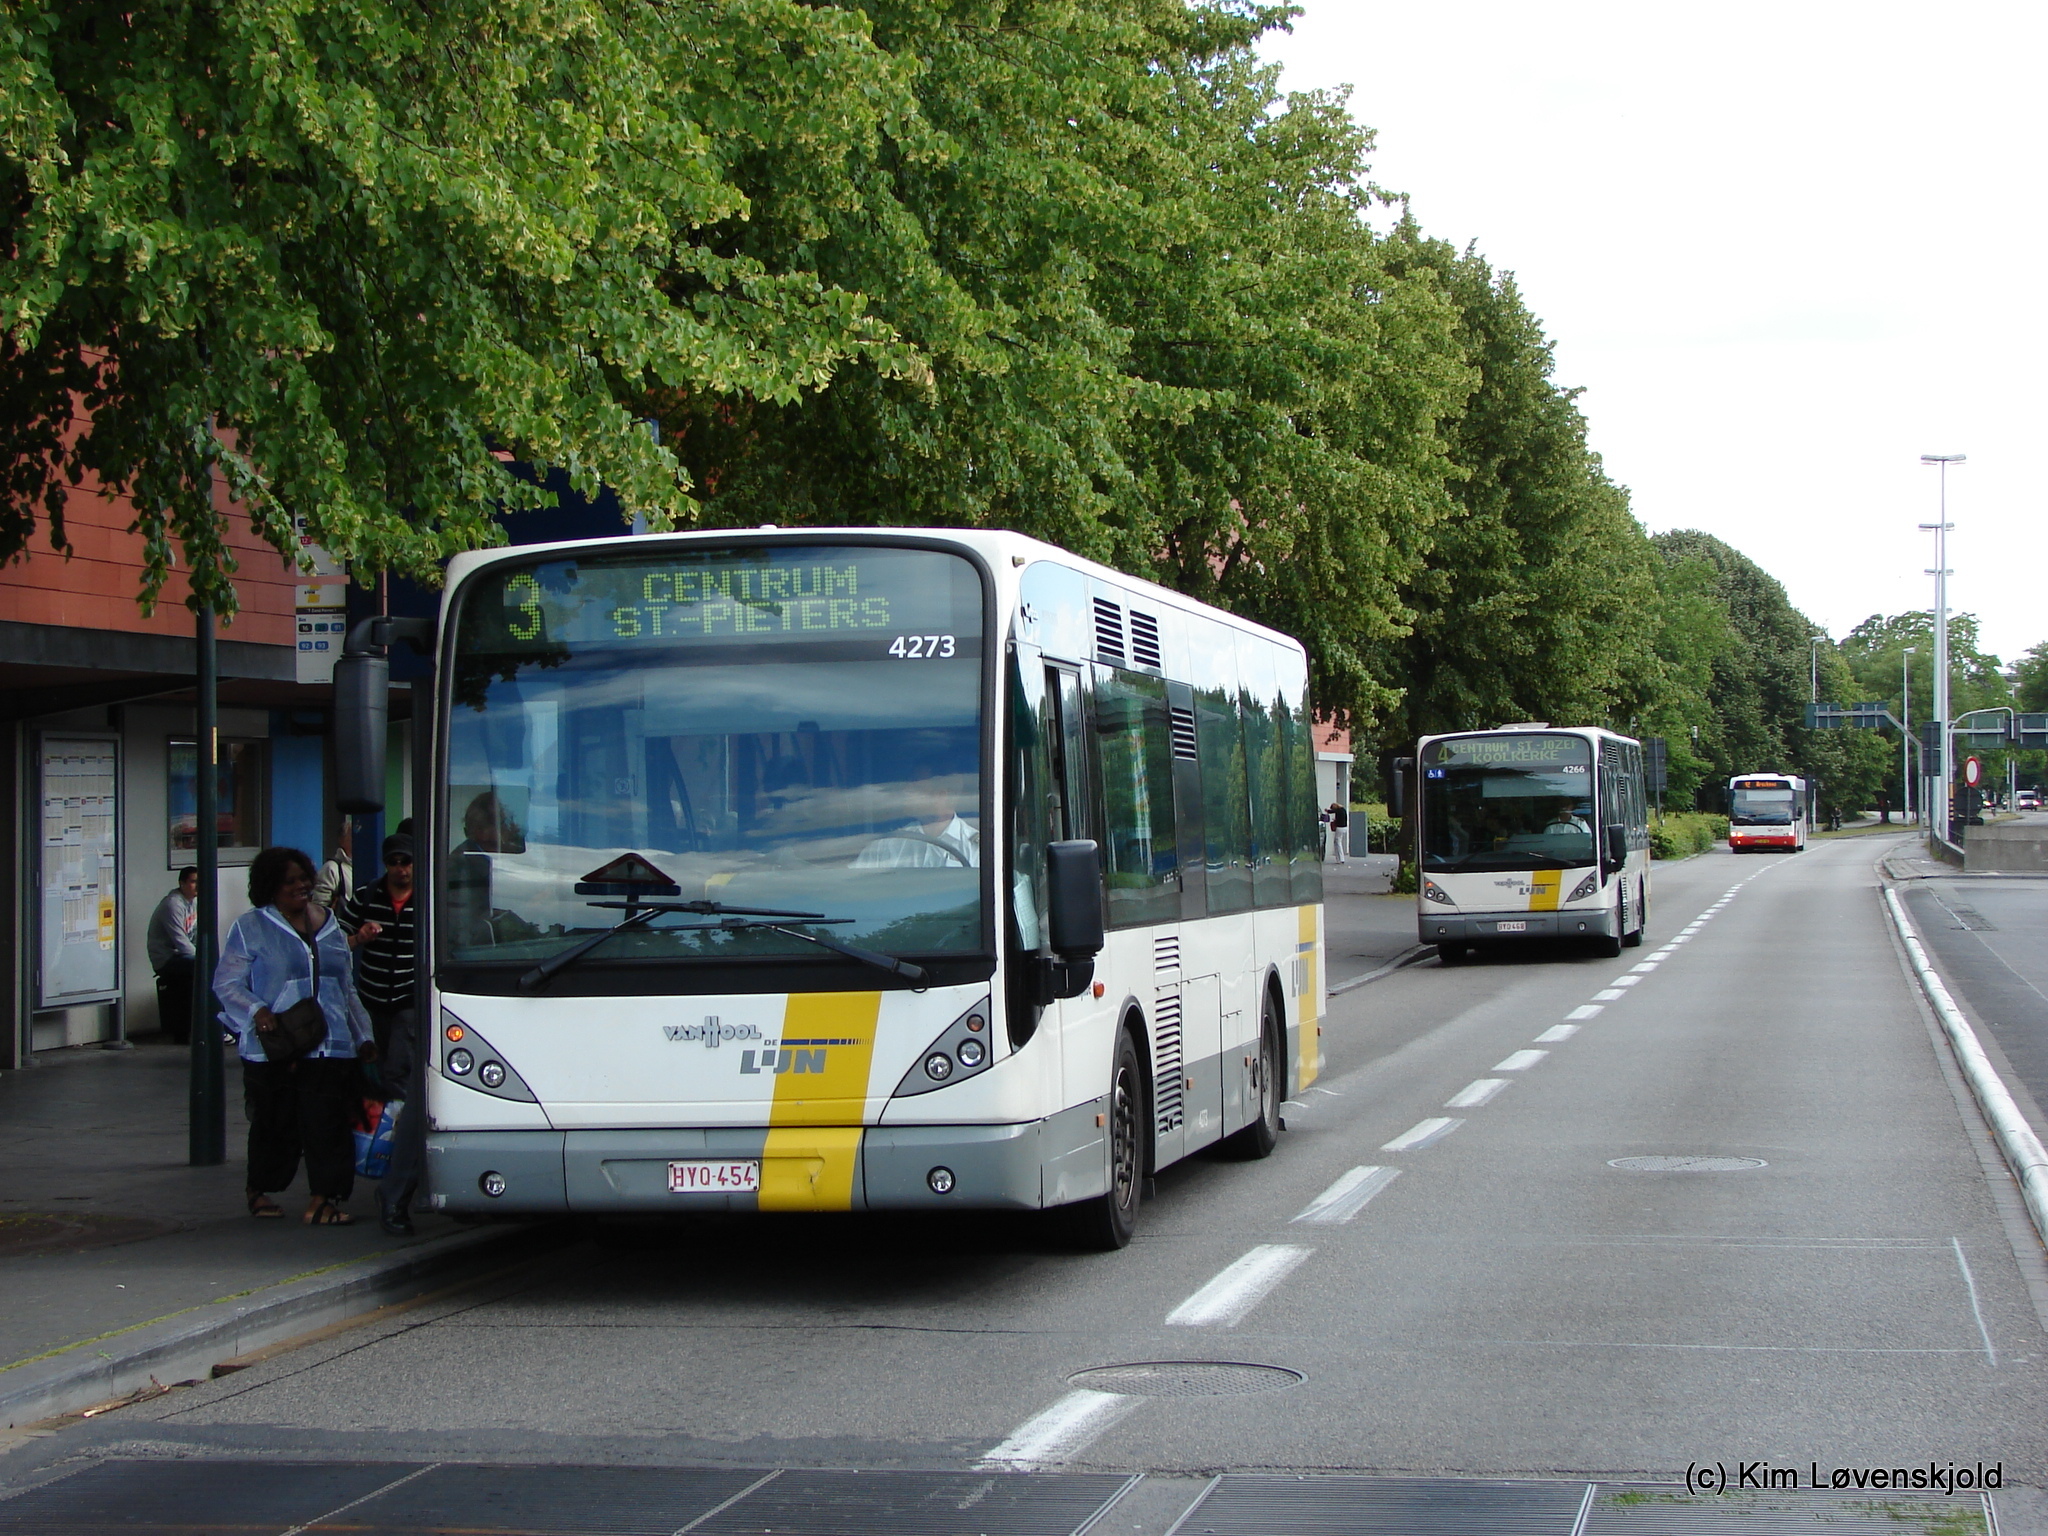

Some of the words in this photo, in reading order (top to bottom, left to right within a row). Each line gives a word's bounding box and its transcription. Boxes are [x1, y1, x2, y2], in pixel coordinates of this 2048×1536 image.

[642, 565, 858, 604] CENTRUM
[508, 573, 541, 641] 3
[613, 597, 891, 638] ST.-PIETERS
[888, 634, 956, 659] 4273
[1437, 743, 1449, 763] 4
[1452, 742, 1510, 755] CENTRUM
[1472, 750, 1559, 763] KOOLKERKE
[1562, 766, 1585, 774] 4266
[739, 1049, 827, 1074] LIJN
